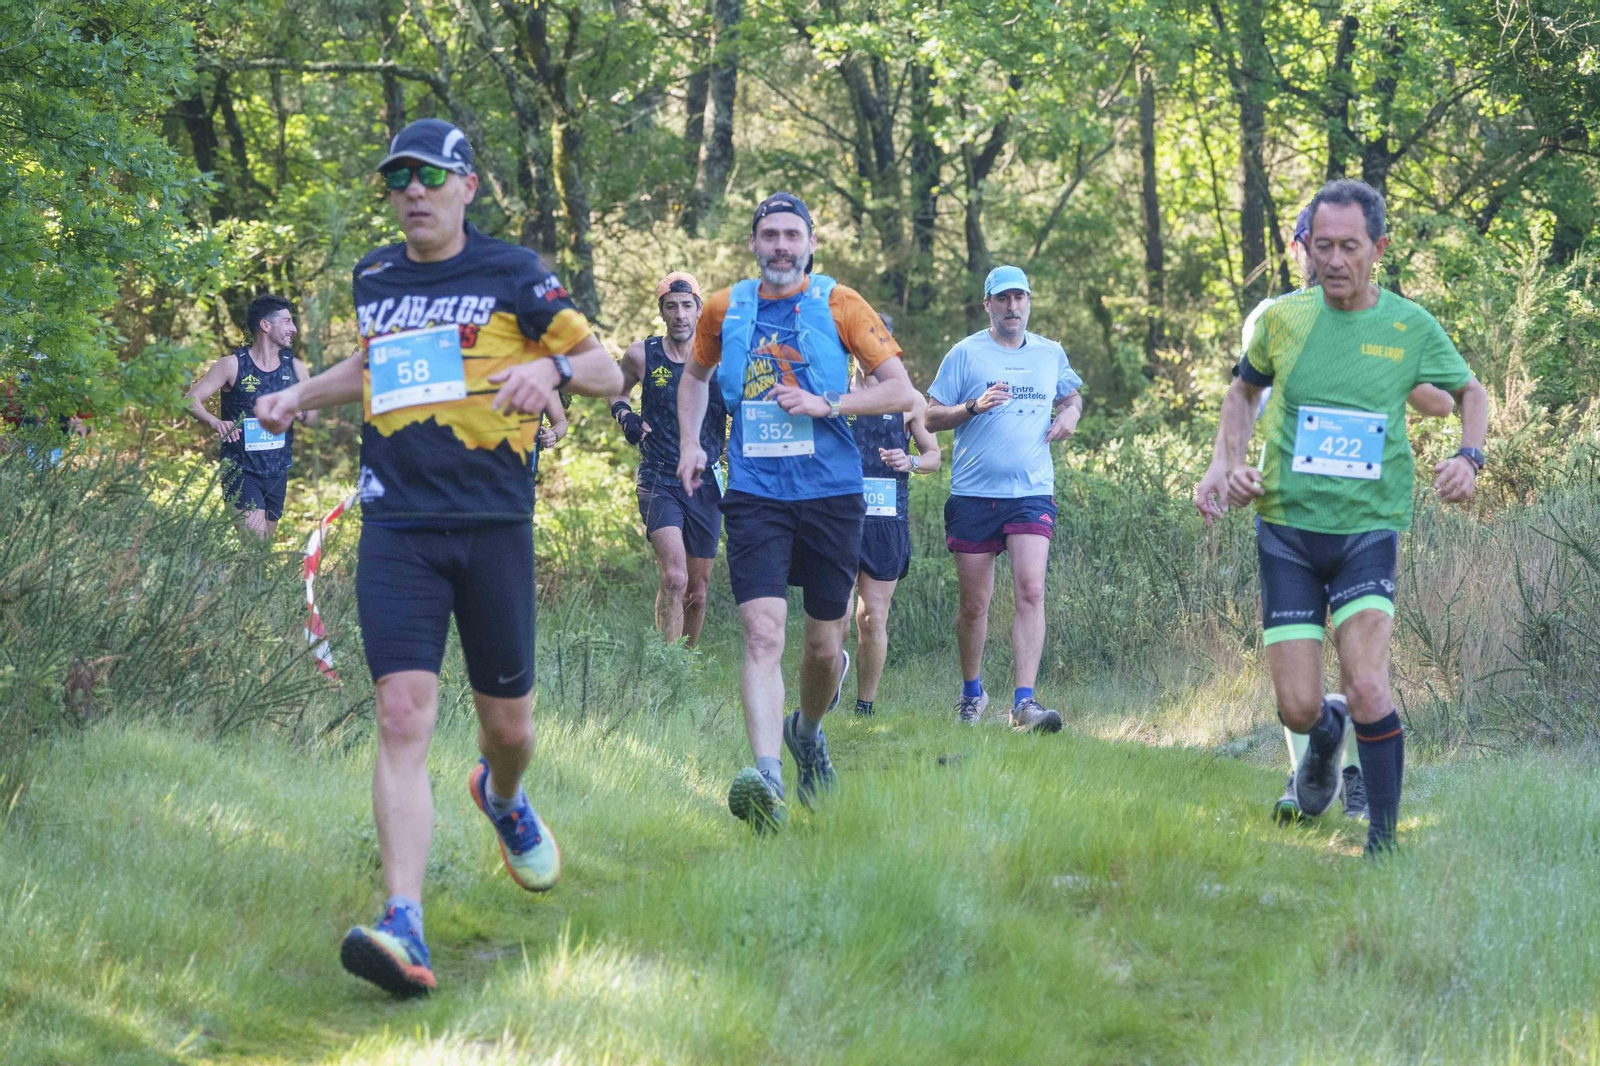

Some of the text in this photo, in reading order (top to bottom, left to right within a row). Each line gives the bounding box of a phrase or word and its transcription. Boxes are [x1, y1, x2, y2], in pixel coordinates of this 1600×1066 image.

[374, 295, 496, 333] CABALOS
[397, 359, 430, 384] 58
[759, 423, 794, 440] 352
[1319, 436, 1362, 458] 422
